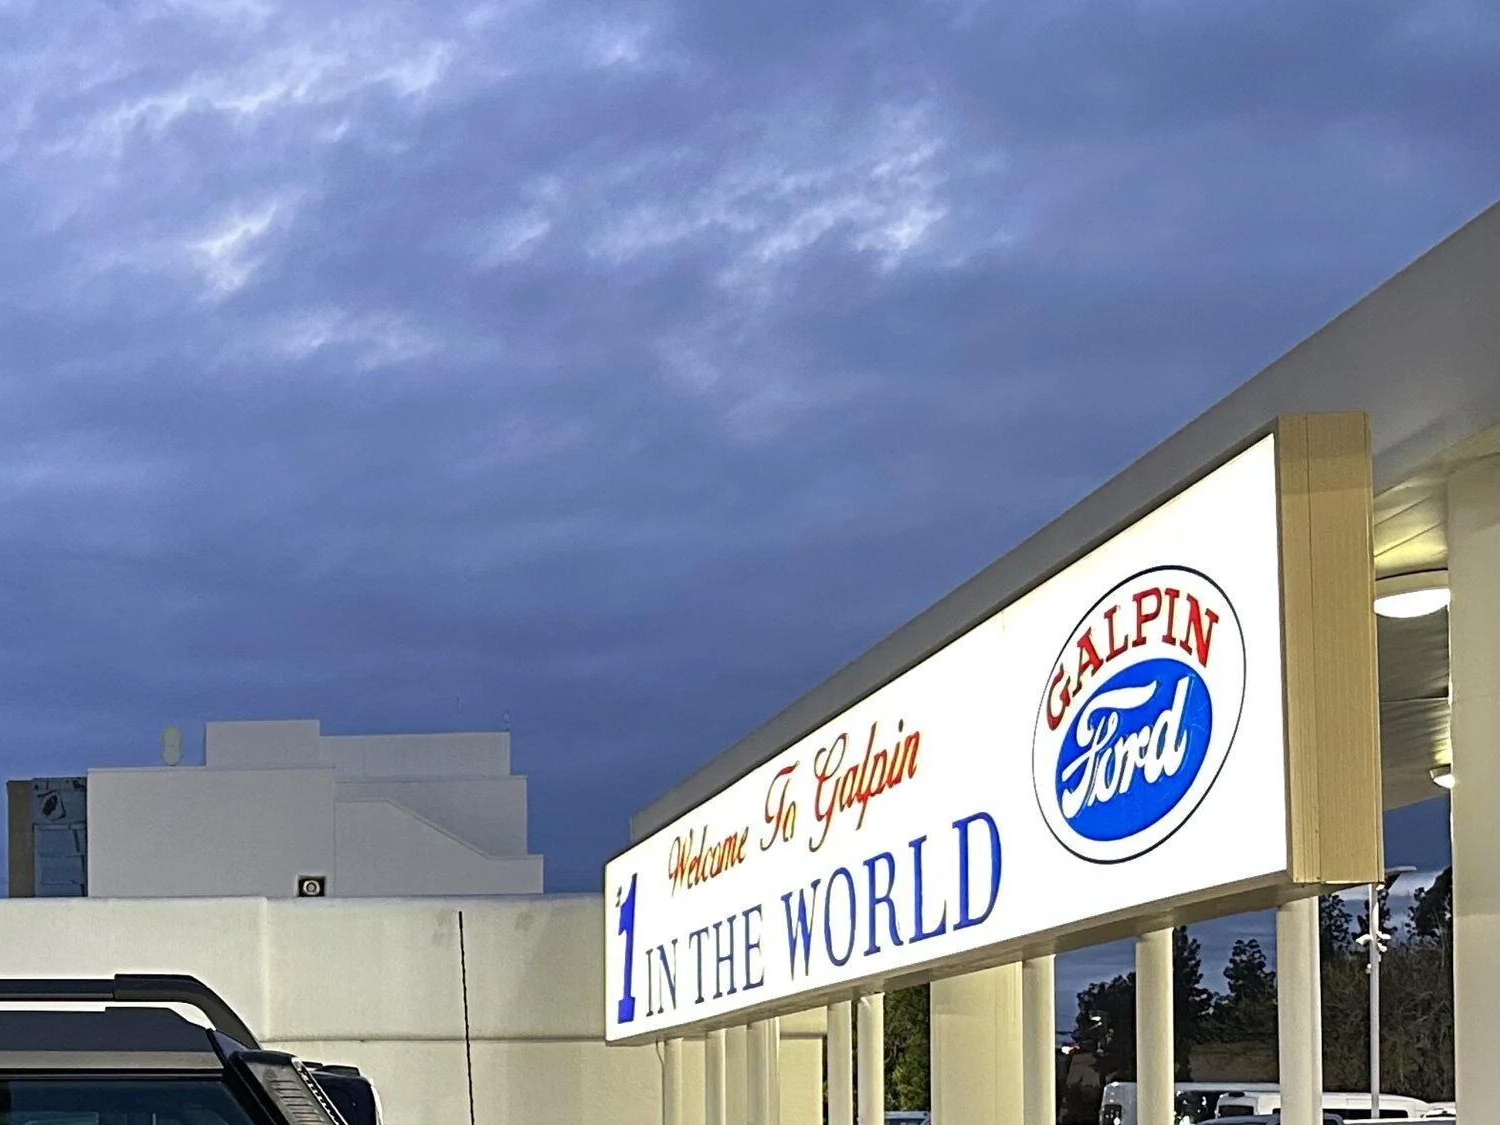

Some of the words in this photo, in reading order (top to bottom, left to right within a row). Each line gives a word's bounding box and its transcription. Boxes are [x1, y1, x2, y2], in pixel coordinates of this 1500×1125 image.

[1047, 587, 1219, 731] GALPIN
[668, 825, 748, 898] Welcome
[760, 761, 799, 851] To
[809, 719, 920, 852] Galpin
[1061, 675, 1193, 819] Ford
[645, 939, 678, 1017] IN
[689, 903, 765, 1004] THE
[781, 812, 1001, 981] WORLD
